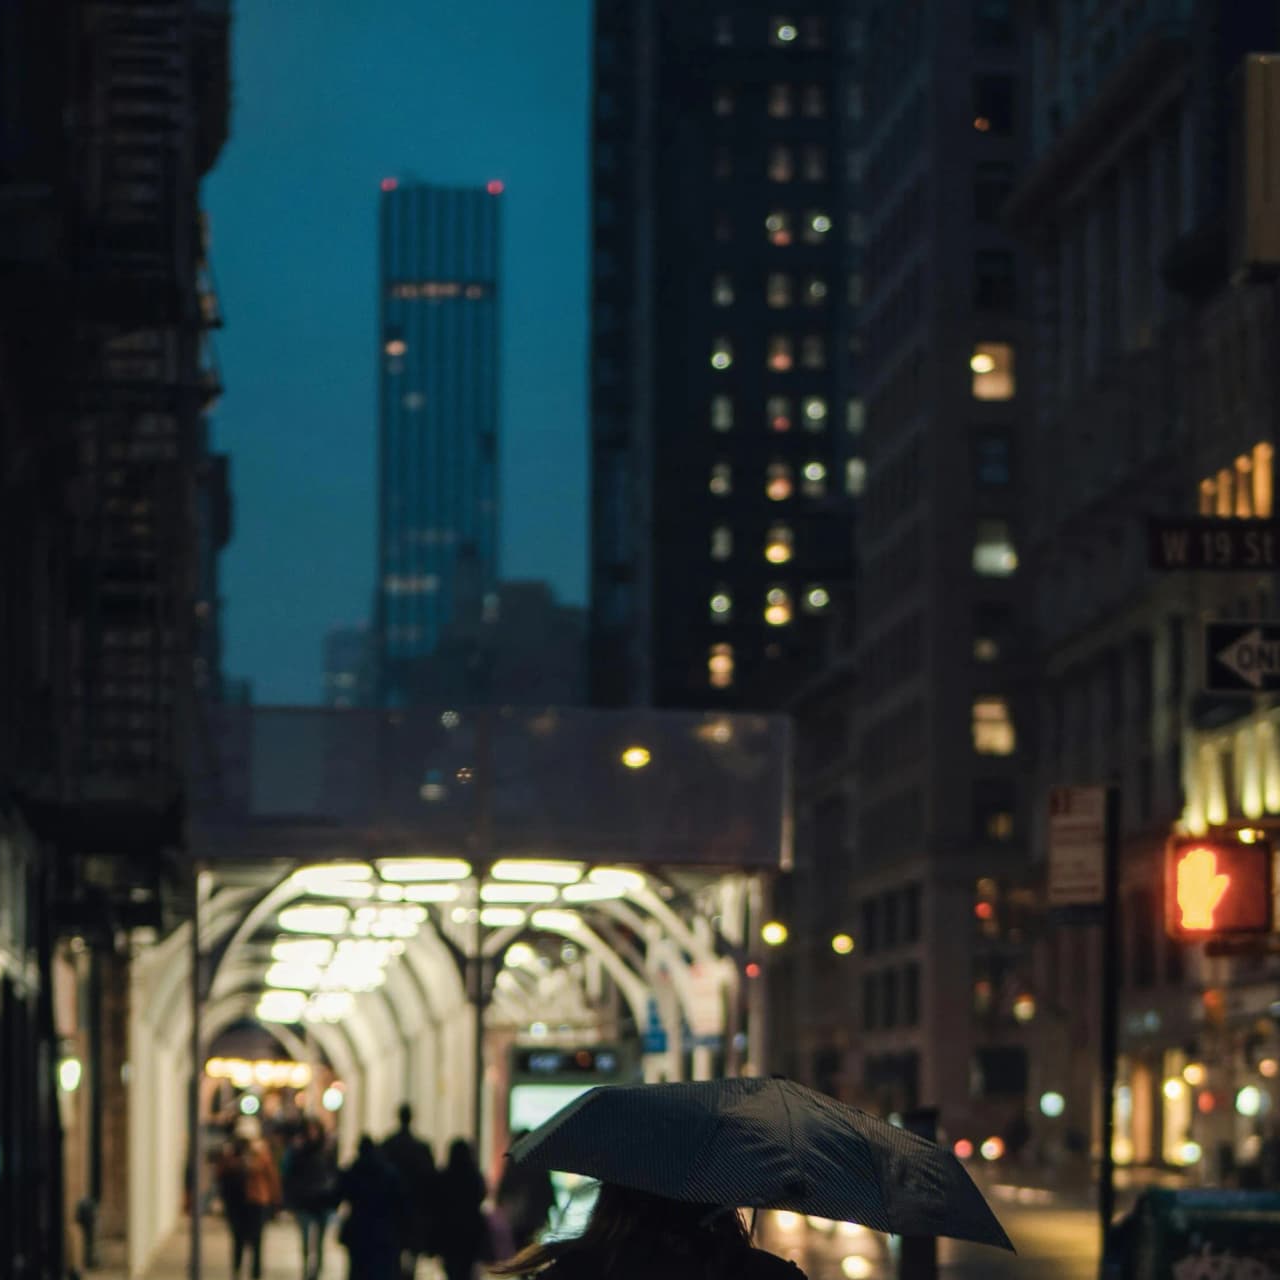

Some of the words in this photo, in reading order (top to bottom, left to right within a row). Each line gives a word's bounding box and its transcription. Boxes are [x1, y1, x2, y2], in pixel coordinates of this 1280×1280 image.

[1161, 529, 1189, 564] W
[1200, 529, 1233, 565] 19
[1244, 529, 1275, 565] St
